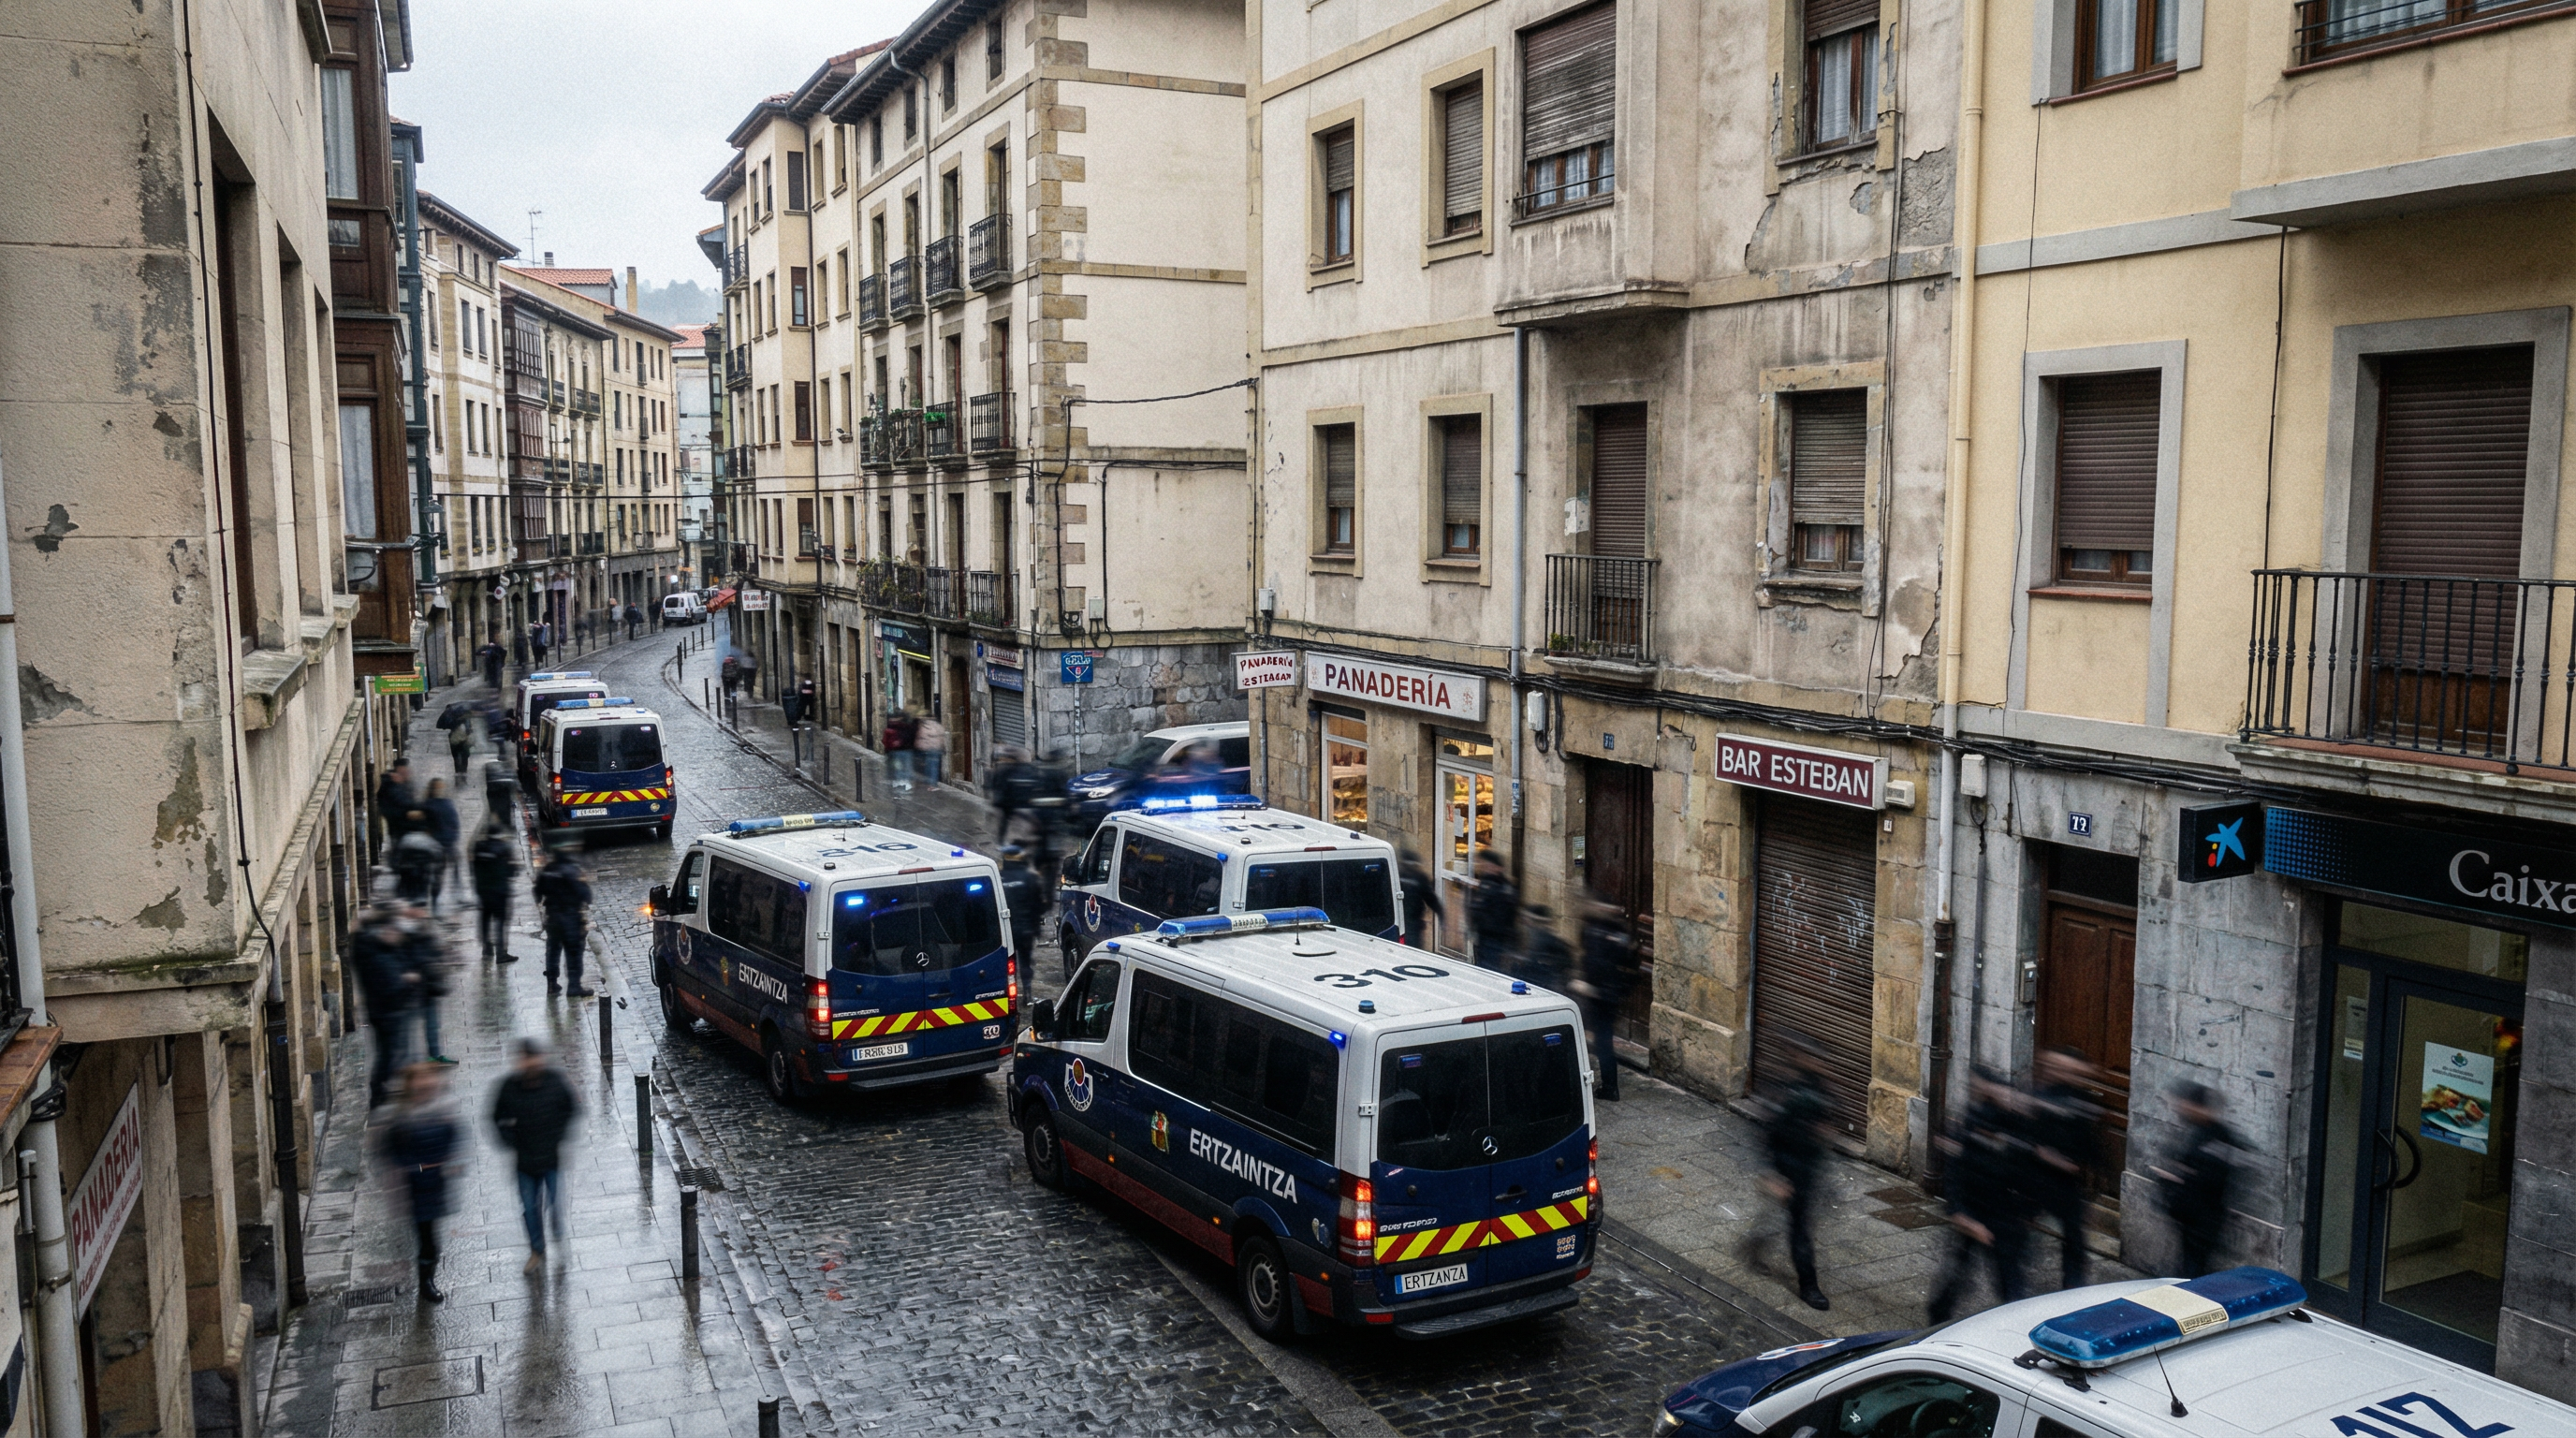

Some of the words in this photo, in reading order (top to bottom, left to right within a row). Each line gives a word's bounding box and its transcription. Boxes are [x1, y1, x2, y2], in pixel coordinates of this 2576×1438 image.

[1325, 663, 1452, 710] PANADERÍA
[1721, 745, 1762, 778] BAR
[1770, 754, 1869, 798] ESTEBAN
[2449, 849, 2576, 914] Caixa
[1313, 964, 1450, 988] 310
[72, 1100, 140, 1269] PANADERÍA
[1189, 1127, 1298, 1205] ERTZAINTZA
